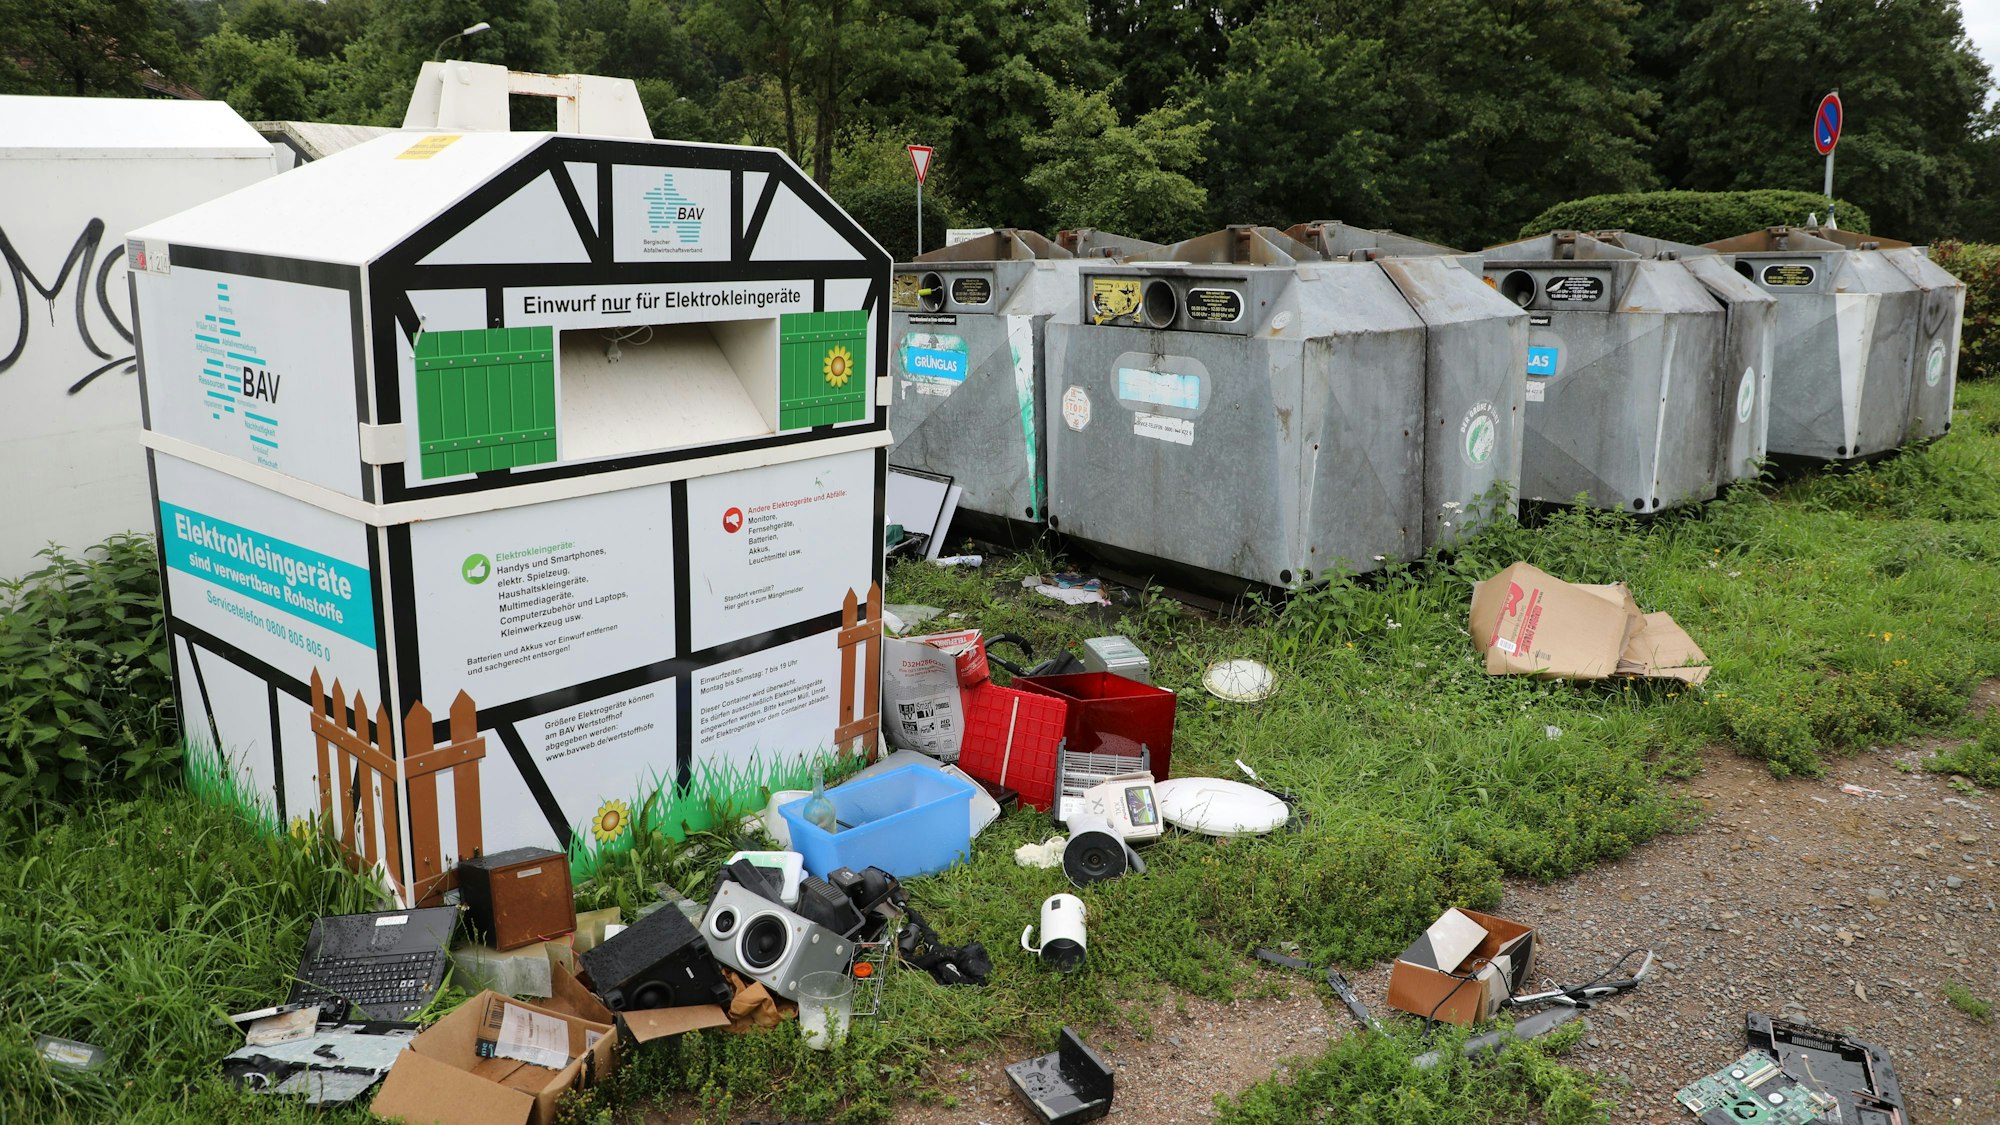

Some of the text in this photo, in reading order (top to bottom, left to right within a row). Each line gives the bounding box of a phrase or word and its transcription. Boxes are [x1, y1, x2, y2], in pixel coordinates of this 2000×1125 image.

[677, 207, 705, 220] BAV
[523, 288, 801, 314] Einwurf nur für Elektrokleingeräte
[914, 355, 958, 372] GRÜNGLAS
[243, 366, 280, 404] BAV
[1460, 416, 1470, 433] DER
[748, 489, 848, 514] Andere Elektrogeräte und Abfälle:
[748, 513, 778, 525] Monitore,
[748, 520, 795, 535] Fernsehgeräte,
[496, 541, 576, 562] Elektrokleingeräte:
[748, 533, 779, 545] Batterien,
[748, 545, 771, 555] Akkus,
[175, 512, 352, 600] Elektrokleingeräte
[497, 548, 607, 575] Handys und Smartphones,
[748, 548, 802, 566] Leuchtmittel usw.
[189, 551, 344, 624] sind verwertbare Rohstoffe
[497, 568, 570, 587] elektr. Spielzeug,
[498, 575, 589, 600] Haushaltskleingeräte,
[498, 591, 574, 613] Multimediageräte,
[724, 584, 775, 603] Standort vermüllt?
[724, 602, 736, 611] Hier
[755, 595, 767, 603] zum
[768, 586, 804, 600] Mängelmelder
[500, 591, 629, 625] Computerzubehör und Laptops,
[206, 589, 331, 662] Servicetelefon 0800 805 805 0
[500, 613, 584, 638] Kleinwerkzeug usw.
[467, 623, 618, 666] Batterien und Akkus vor Einwurf entfernen
[467, 644, 571, 676] und sachgerecht entsorgen!
[700, 667, 744, 685] Einwurfzeiten:
[700, 682, 724, 695] Montag
[725, 680, 734, 688] bis
[735, 671, 764, 683] Samstag:
[769, 665, 778, 673] bis
[787, 659, 798, 668] Uhr
[700, 679, 797, 715] Dieser Container wird überwacht.
[700, 679, 823, 725] Es dürfen ausschließlich Elektrokleingeräte
[899, 704, 915, 714] LED
[916, 701, 932, 711] Smart
[544, 692, 655, 730] Größere Elektrogeräte können
[700, 717, 738, 735] eingeworfen
[739, 709, 762, 721] werden.
[763, 703, 777, 713] Bitte
[778, 697, 796, 707] keinen
[811, 686, 826, 696] Unrat
[700, 735, 715, 744] oder
[715, 721, 756, 739] Elektrogeräte
[767, 712, 780, 721] dem
[780, 702, 808, 716] Container
[808, 694, 831, 706] abladen.
[545, 711, 623, 740] am BAV Wertstoffhof
[545, 724, 619, 751] abgegeben werden:
[545, 722, 655, 762] www.bavweb.de/wertstoffhöfe
